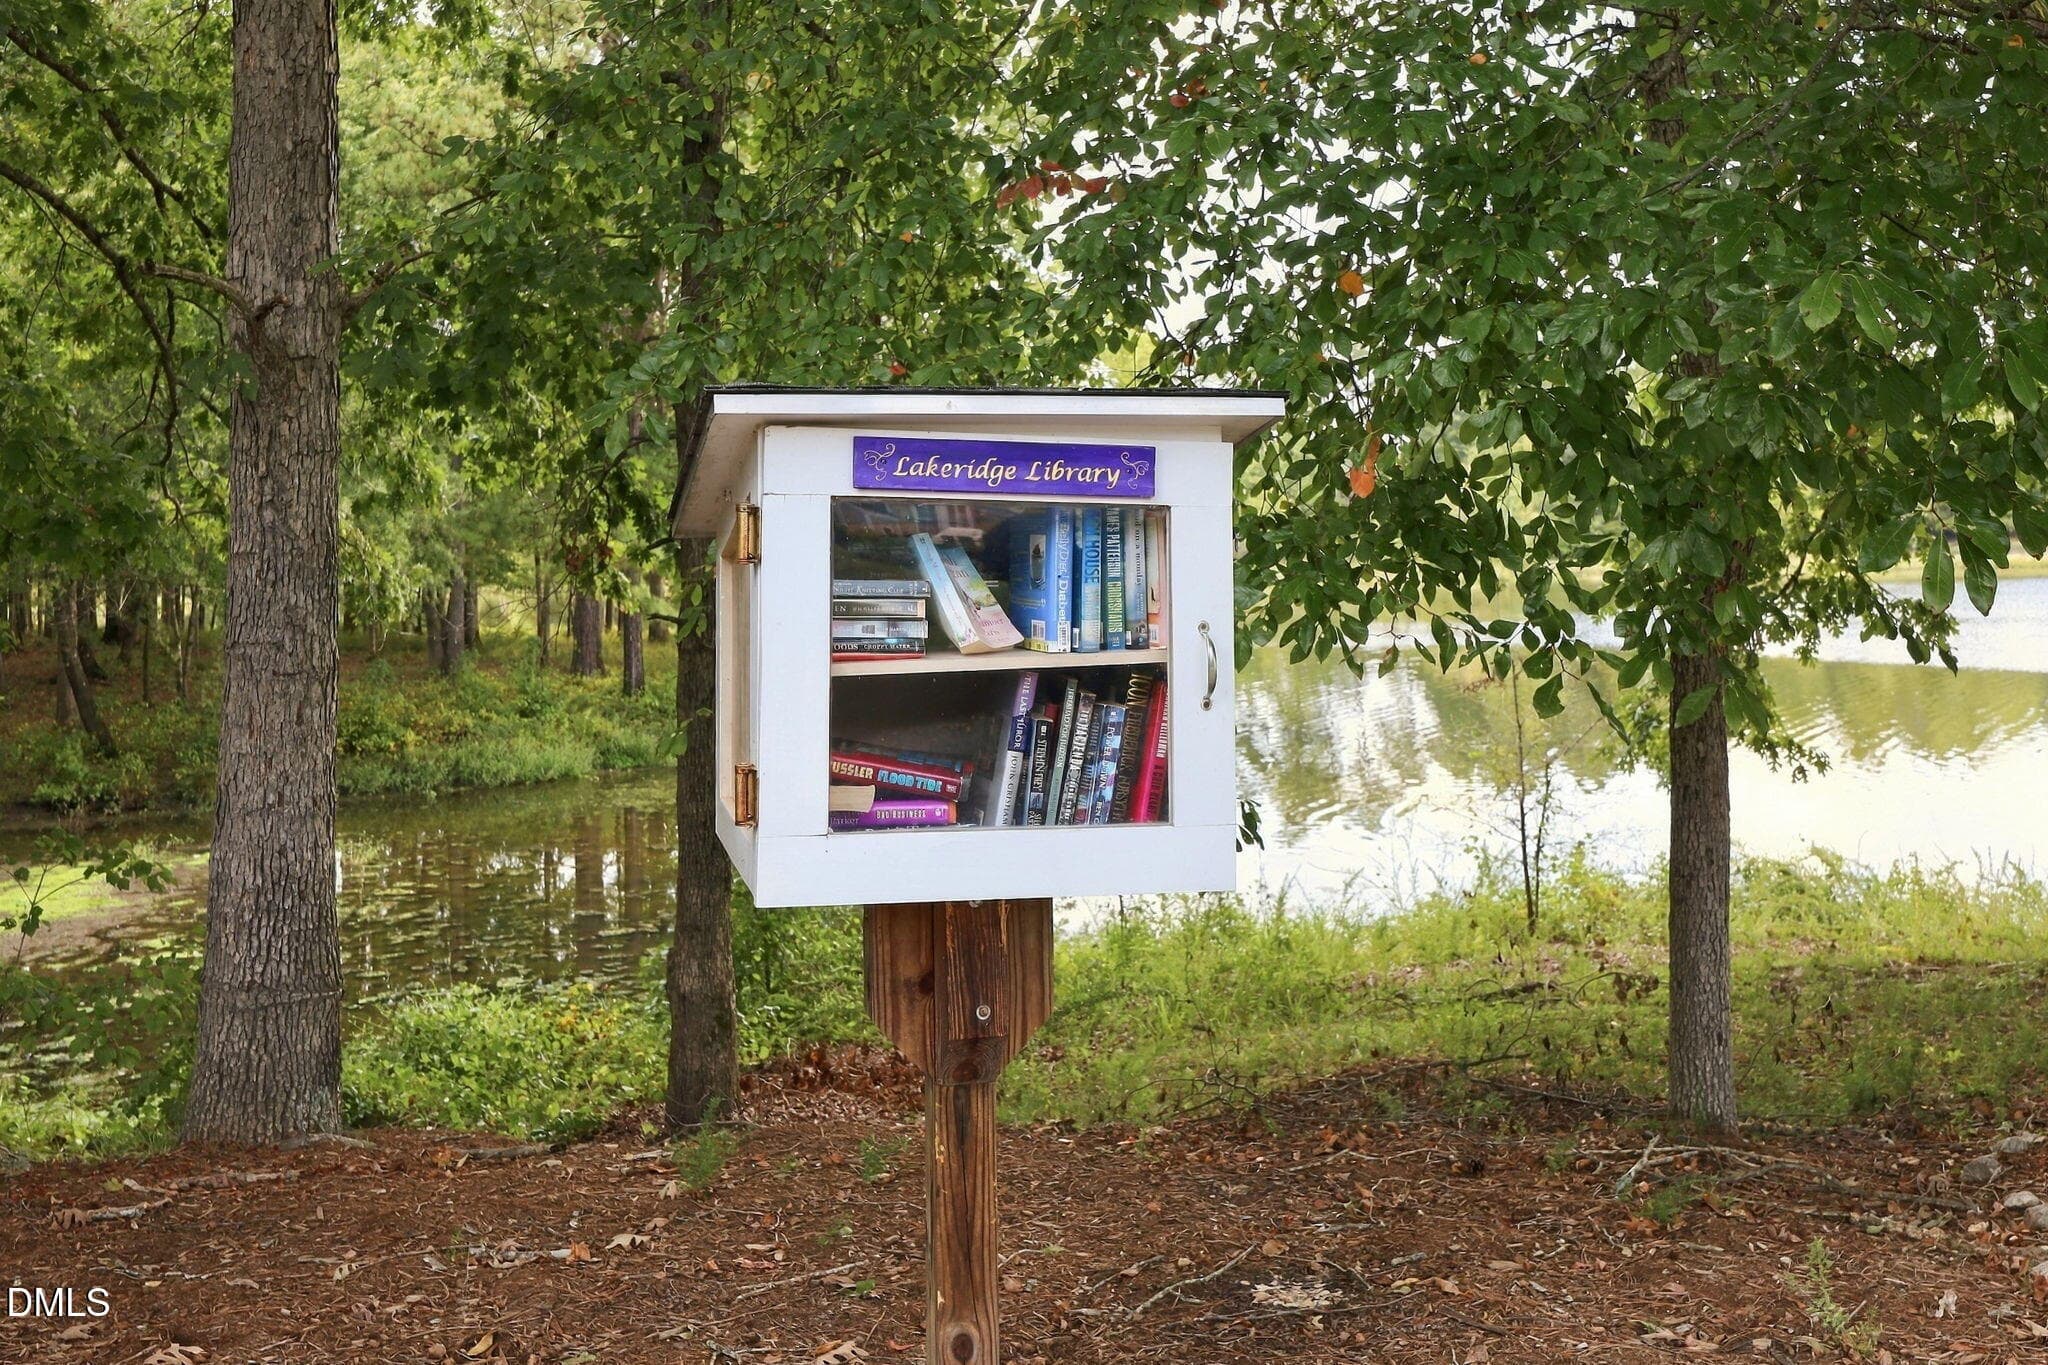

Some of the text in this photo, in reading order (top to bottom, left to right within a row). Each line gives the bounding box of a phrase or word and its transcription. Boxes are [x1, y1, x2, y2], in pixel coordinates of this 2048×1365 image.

[893, 455, 1121, 489] Lakeridge Library
[1085, 540, 1100, 584] HOUSE
[1107, 534, 1121, 578] PATTERSON
[1022, 674, 1031, 694] THE
[1126, 674, 1152, 708] ICON
[1014, 716, 1027, 749] JUROR
[877, 769, 914, 787] FLOOD
[915, 777, 943, 793] TIDE
